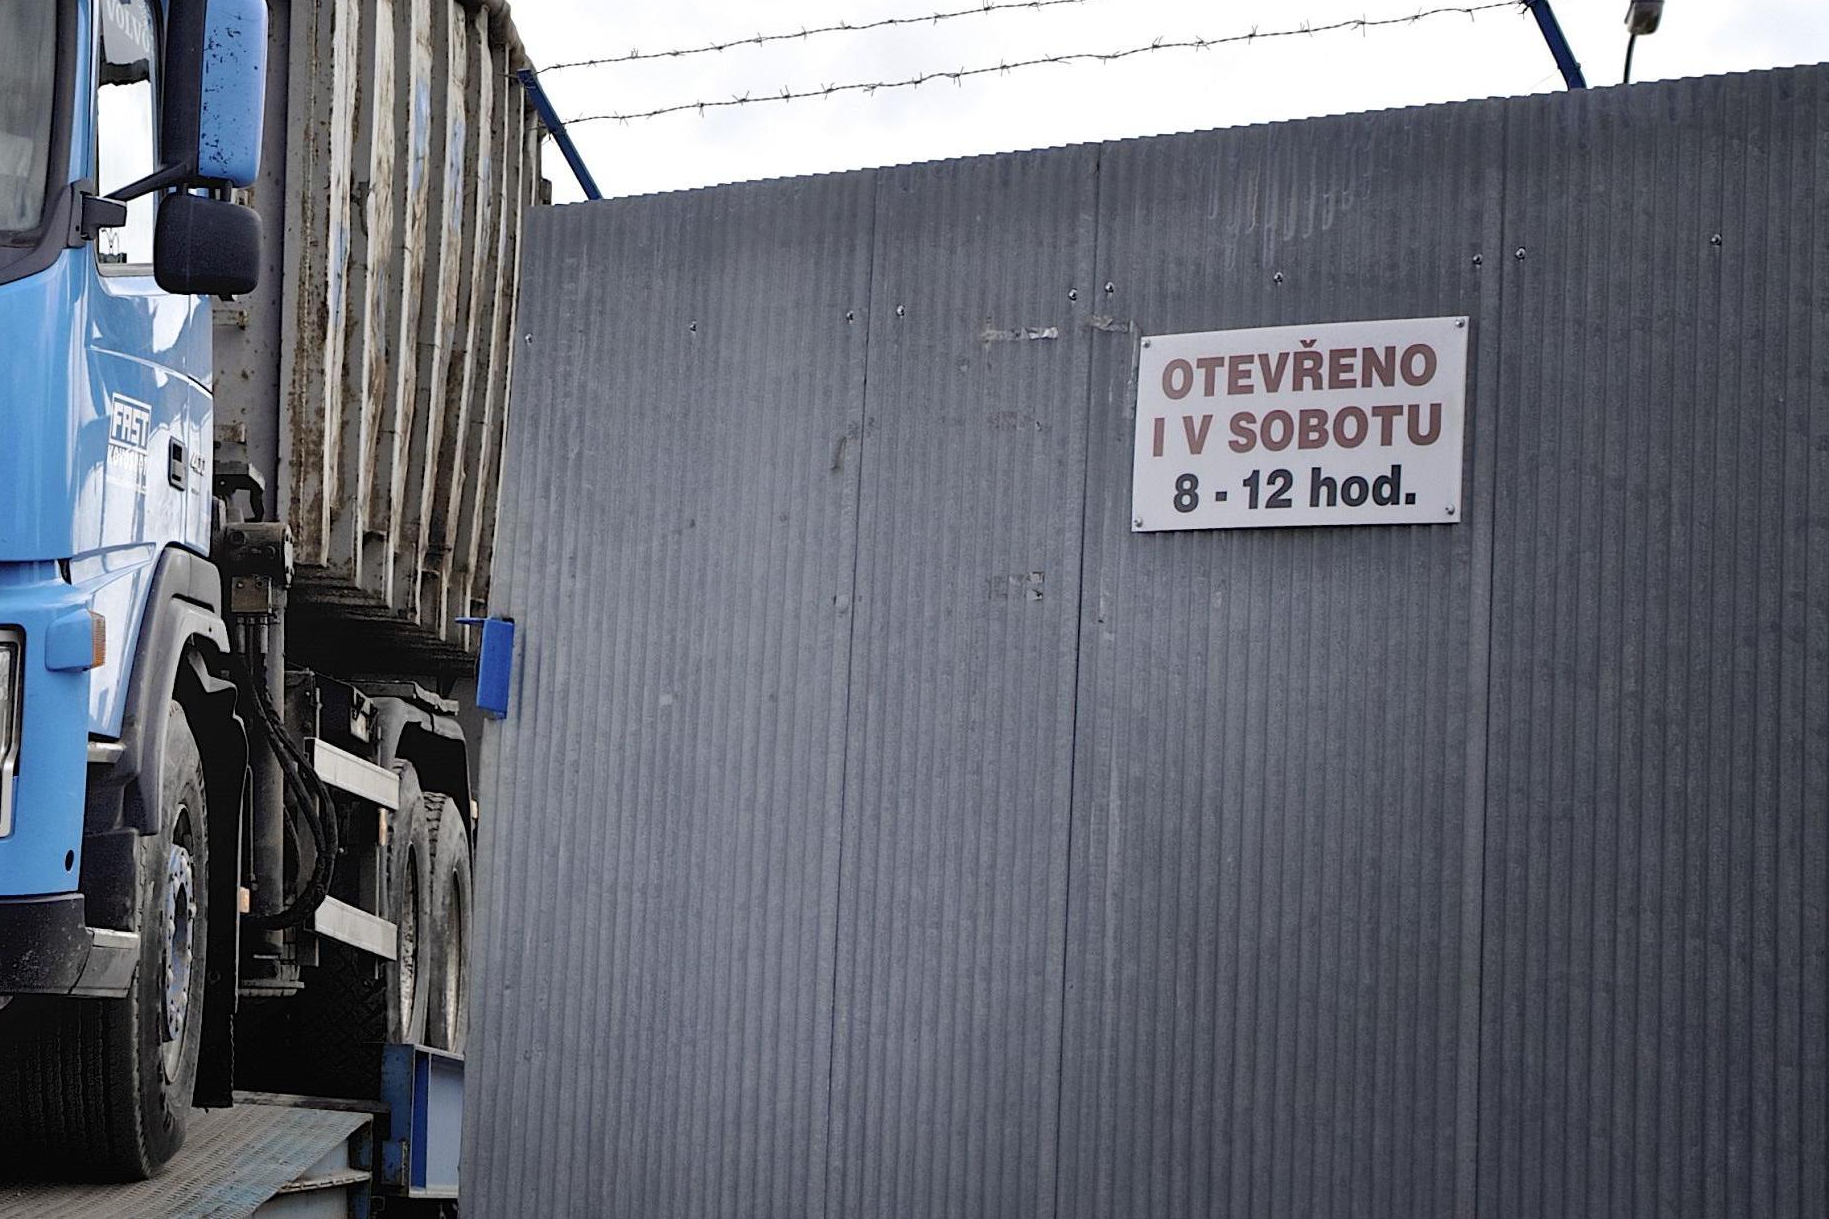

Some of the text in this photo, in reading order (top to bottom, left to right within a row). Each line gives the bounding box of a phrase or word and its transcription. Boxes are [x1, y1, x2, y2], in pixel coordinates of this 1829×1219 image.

[1161, 339, 1438, 400] OTEVŘENO
[111, 400, 150, 449] FAST
[1152, 403, 1442, 457] I V SOBOTU
[1173, 473, 1199, 513] 8
[1242, 468, 1293, 509] 12
[1309, 464, 1416, 507] hod.
